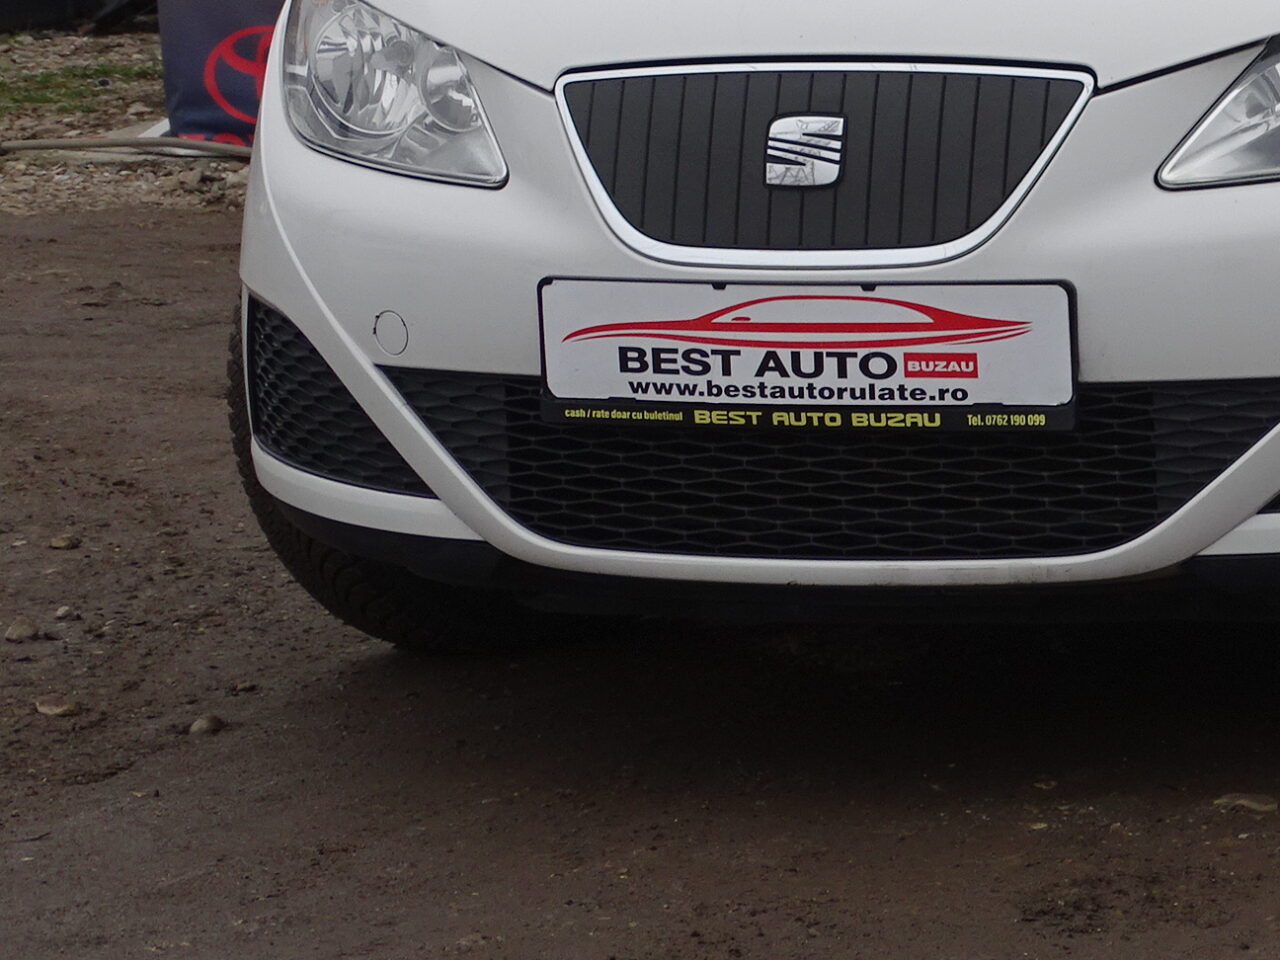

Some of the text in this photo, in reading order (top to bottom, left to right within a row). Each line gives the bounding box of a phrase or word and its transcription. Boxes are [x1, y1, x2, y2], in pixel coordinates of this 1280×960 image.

[618, 346, 975, 380] BEST AUTO BUZAU
[627, 379, 970, 402] www.bestautorulate.ro
[564, 408, 586, 419] cash
[592, 409, 610, 420] rate
[611, 409, 631, 420] doar
[631, 411, 643, 420] cu
[643, 409, 684, 422] buletinul
[693, 409, 763, 426] BEST
[771, 410, 843, 427] AUTO
[850, 412, 941, 428] BUZAU
[966, 414, 984, 426] Tel.
[985, 414, 1009, 427] 0762
[1010, 414, 1026, 427] 190
[1027, 414, 1046, 427] 099
